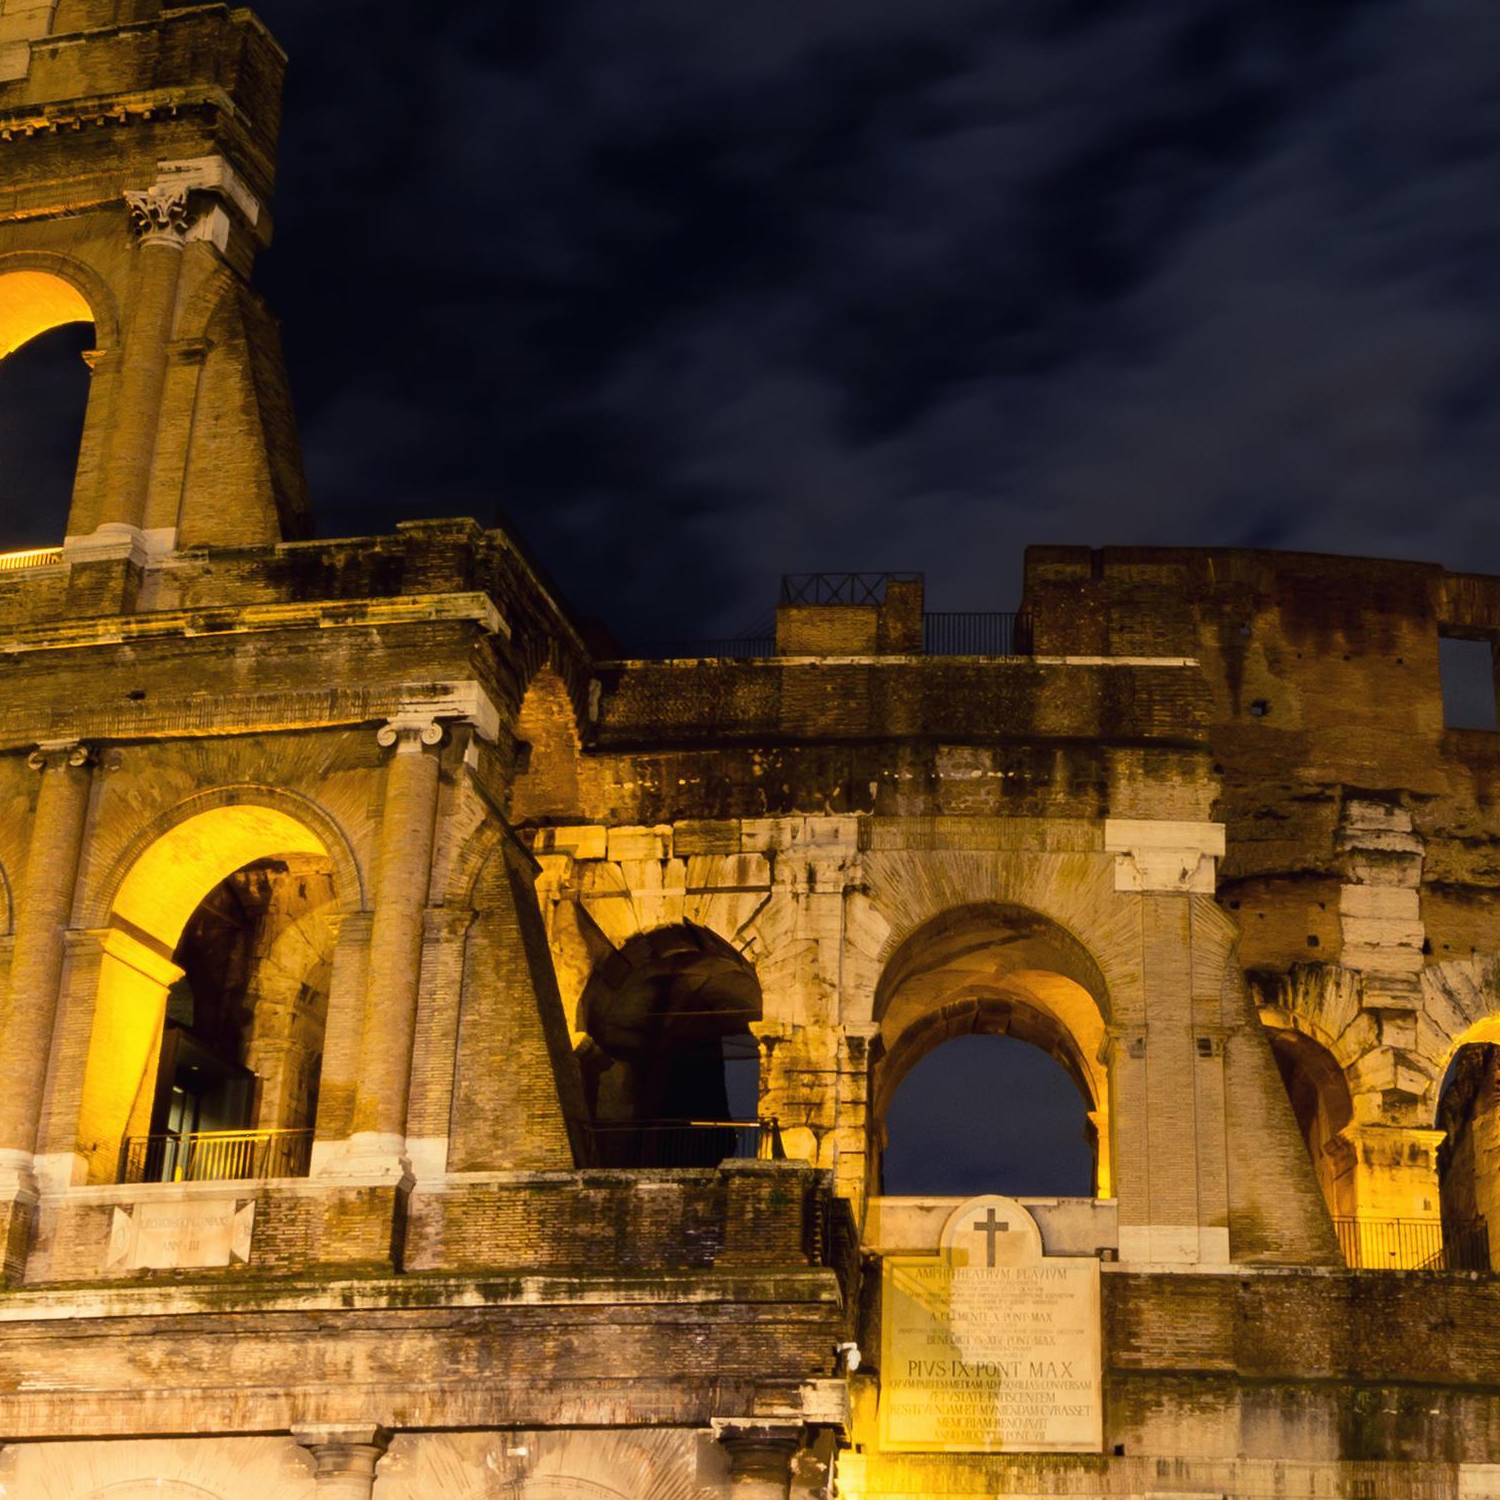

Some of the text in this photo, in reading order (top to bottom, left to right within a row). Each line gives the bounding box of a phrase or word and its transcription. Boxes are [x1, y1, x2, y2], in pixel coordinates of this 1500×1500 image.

[908, 1360, 1073, 1378] PIVS IX PONT MAX
[1040, 1405, 1093, 1417] CVRASSET
